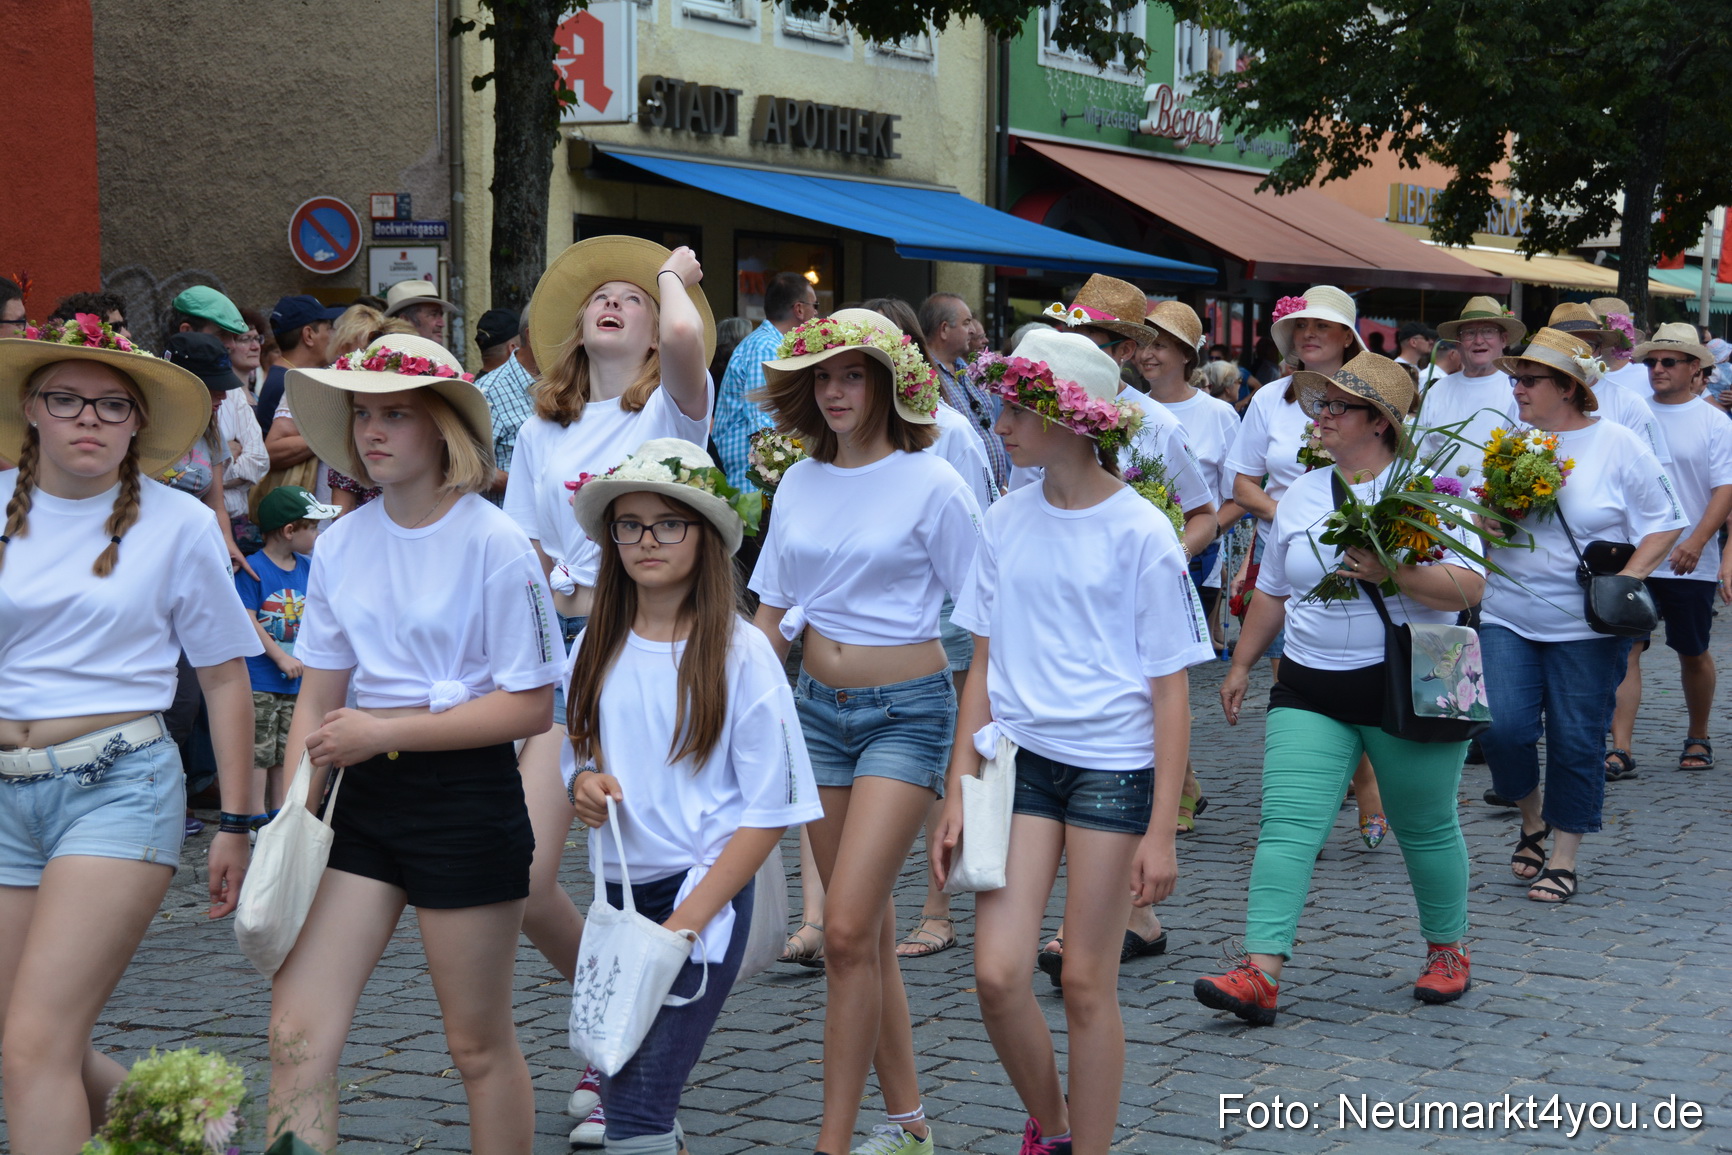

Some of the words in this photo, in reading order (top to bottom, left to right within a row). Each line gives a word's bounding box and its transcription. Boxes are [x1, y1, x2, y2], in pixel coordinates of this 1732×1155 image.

[640, 75, 743, 137] STADT
[751, 95, 902, 159] APOTHEKE
[374, 222, 445, 239] Bockwirtsgasse
[1197, 616, 1208, 642] KLEIN
